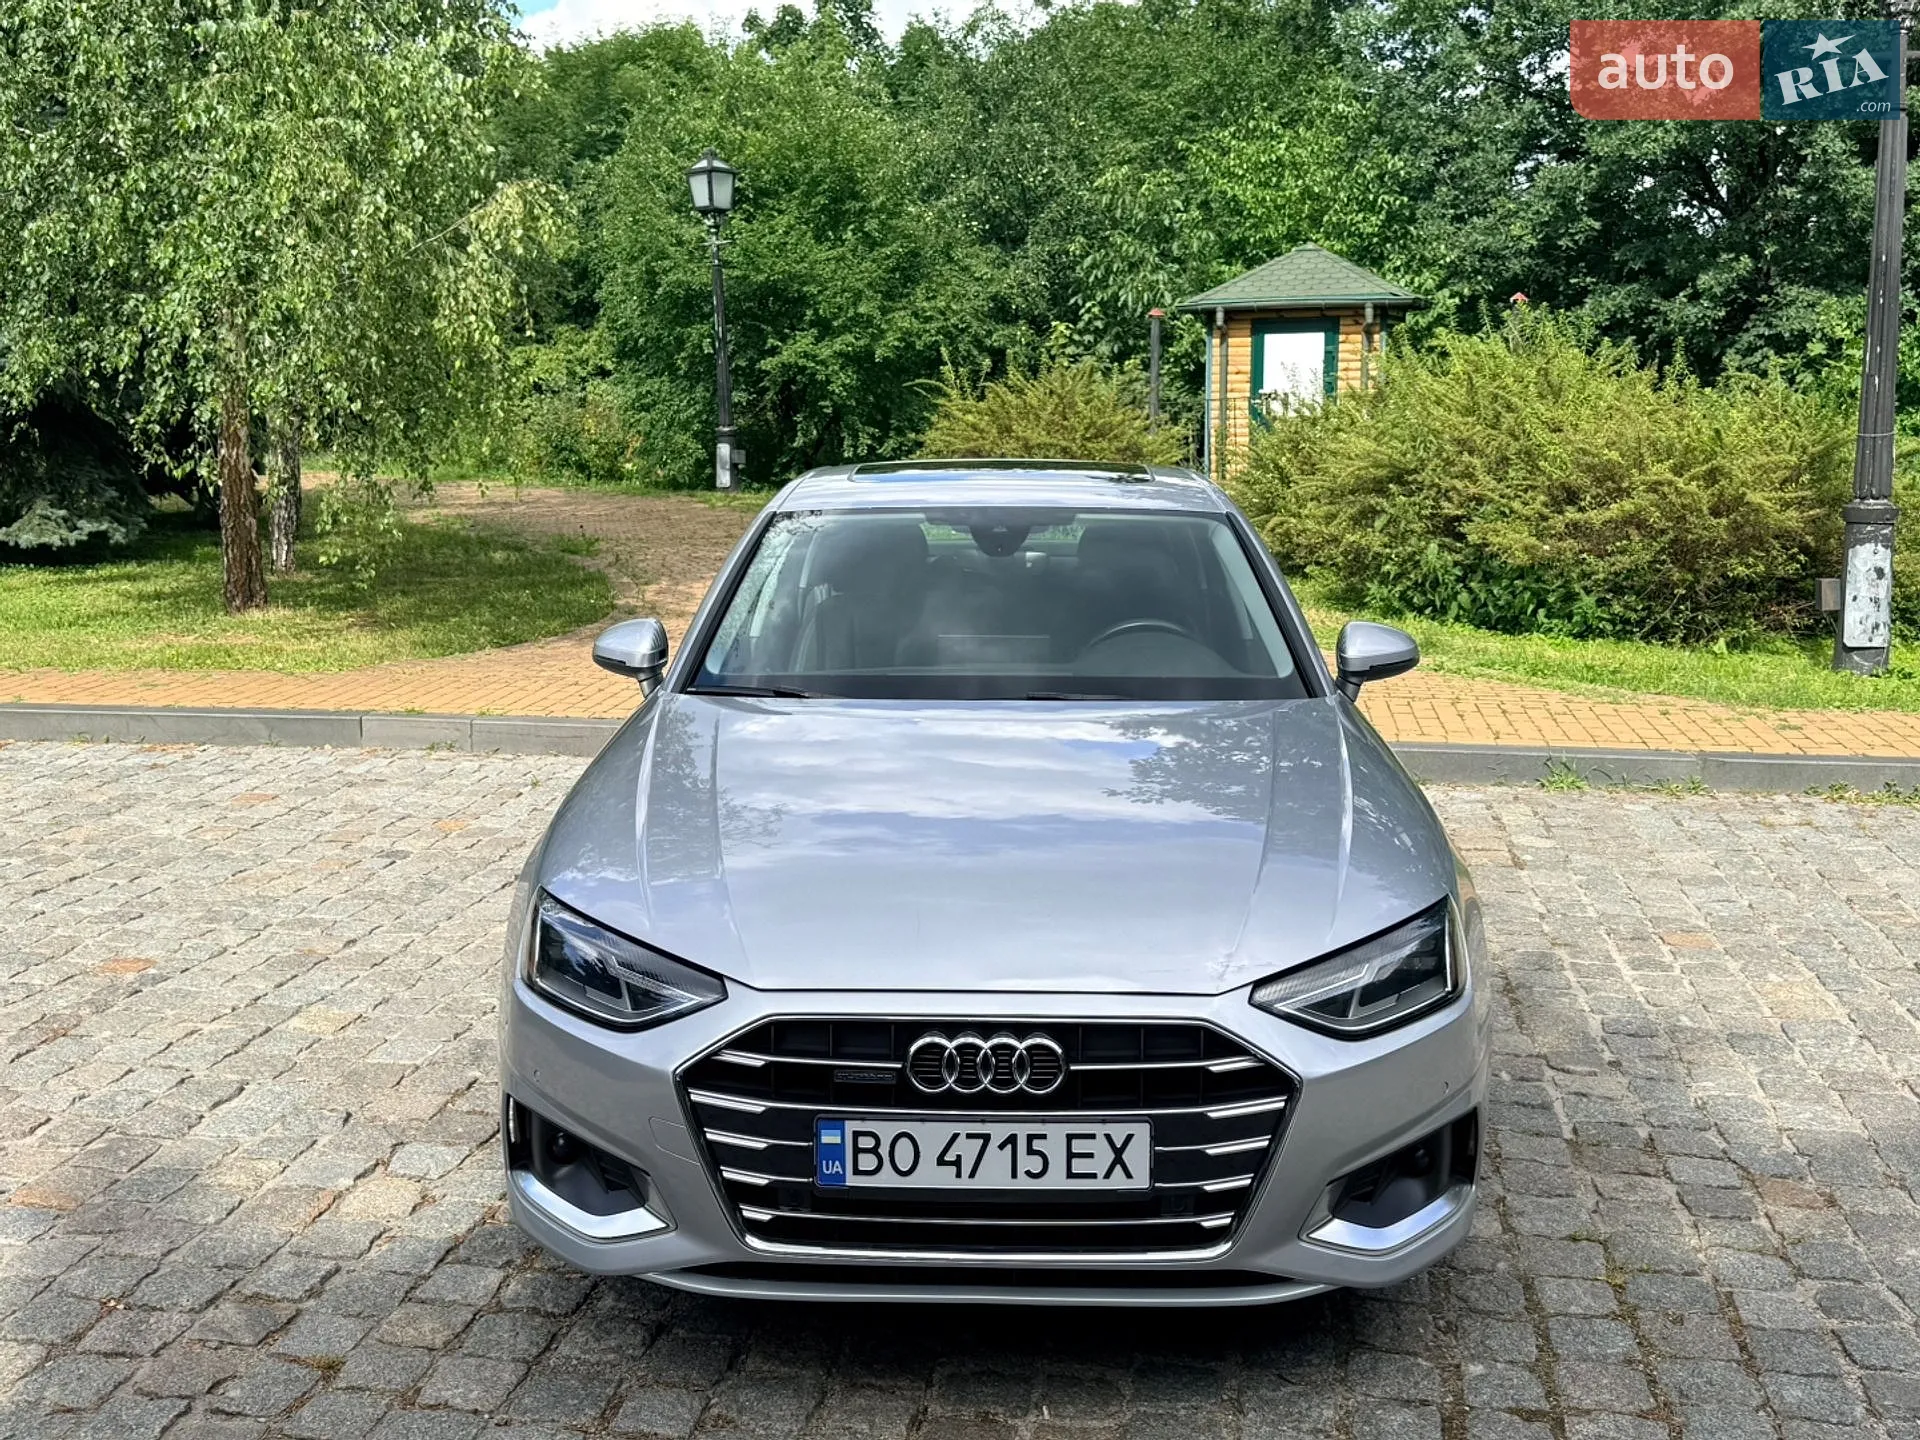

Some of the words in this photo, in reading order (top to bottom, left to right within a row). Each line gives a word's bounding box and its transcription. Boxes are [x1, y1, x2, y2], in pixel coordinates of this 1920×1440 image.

[822, 1160, 843, 1175] UA
[852, 1129, 921, 1177] BO
[935, 1132, 1050, 1180] 4715
[1065, 1132, 1135, 1180] EX
